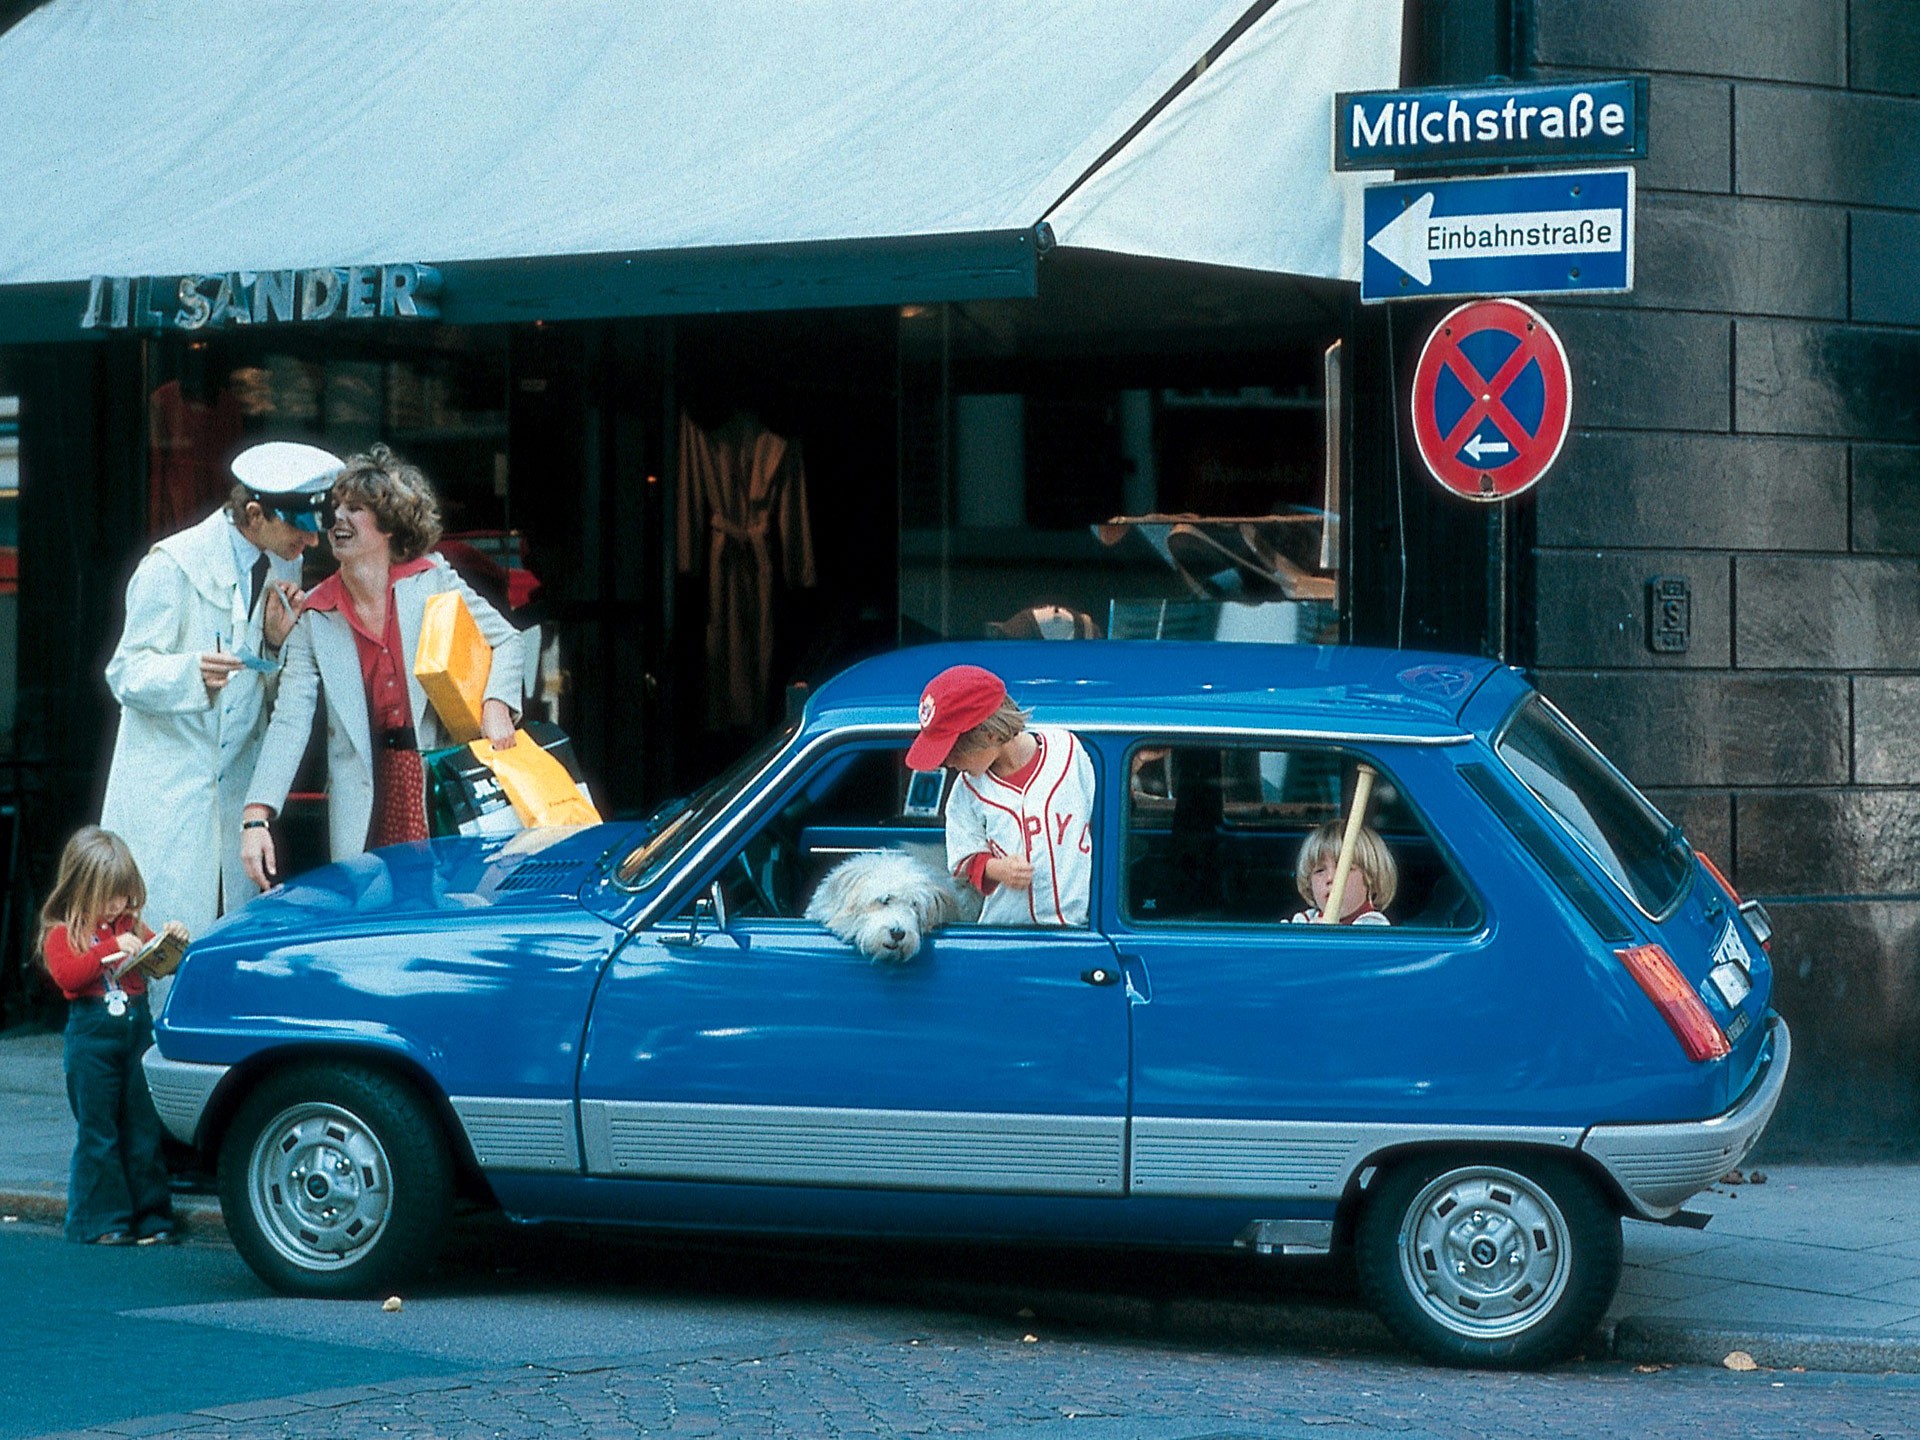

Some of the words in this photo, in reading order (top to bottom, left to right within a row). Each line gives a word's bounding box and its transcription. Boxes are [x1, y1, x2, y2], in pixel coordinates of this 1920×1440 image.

[1352, 92, 1625, 147] Milchstraße
[1427, 219, 1612, 251] Einbahnstraße
[174, 264, 419, 330] SANDER
